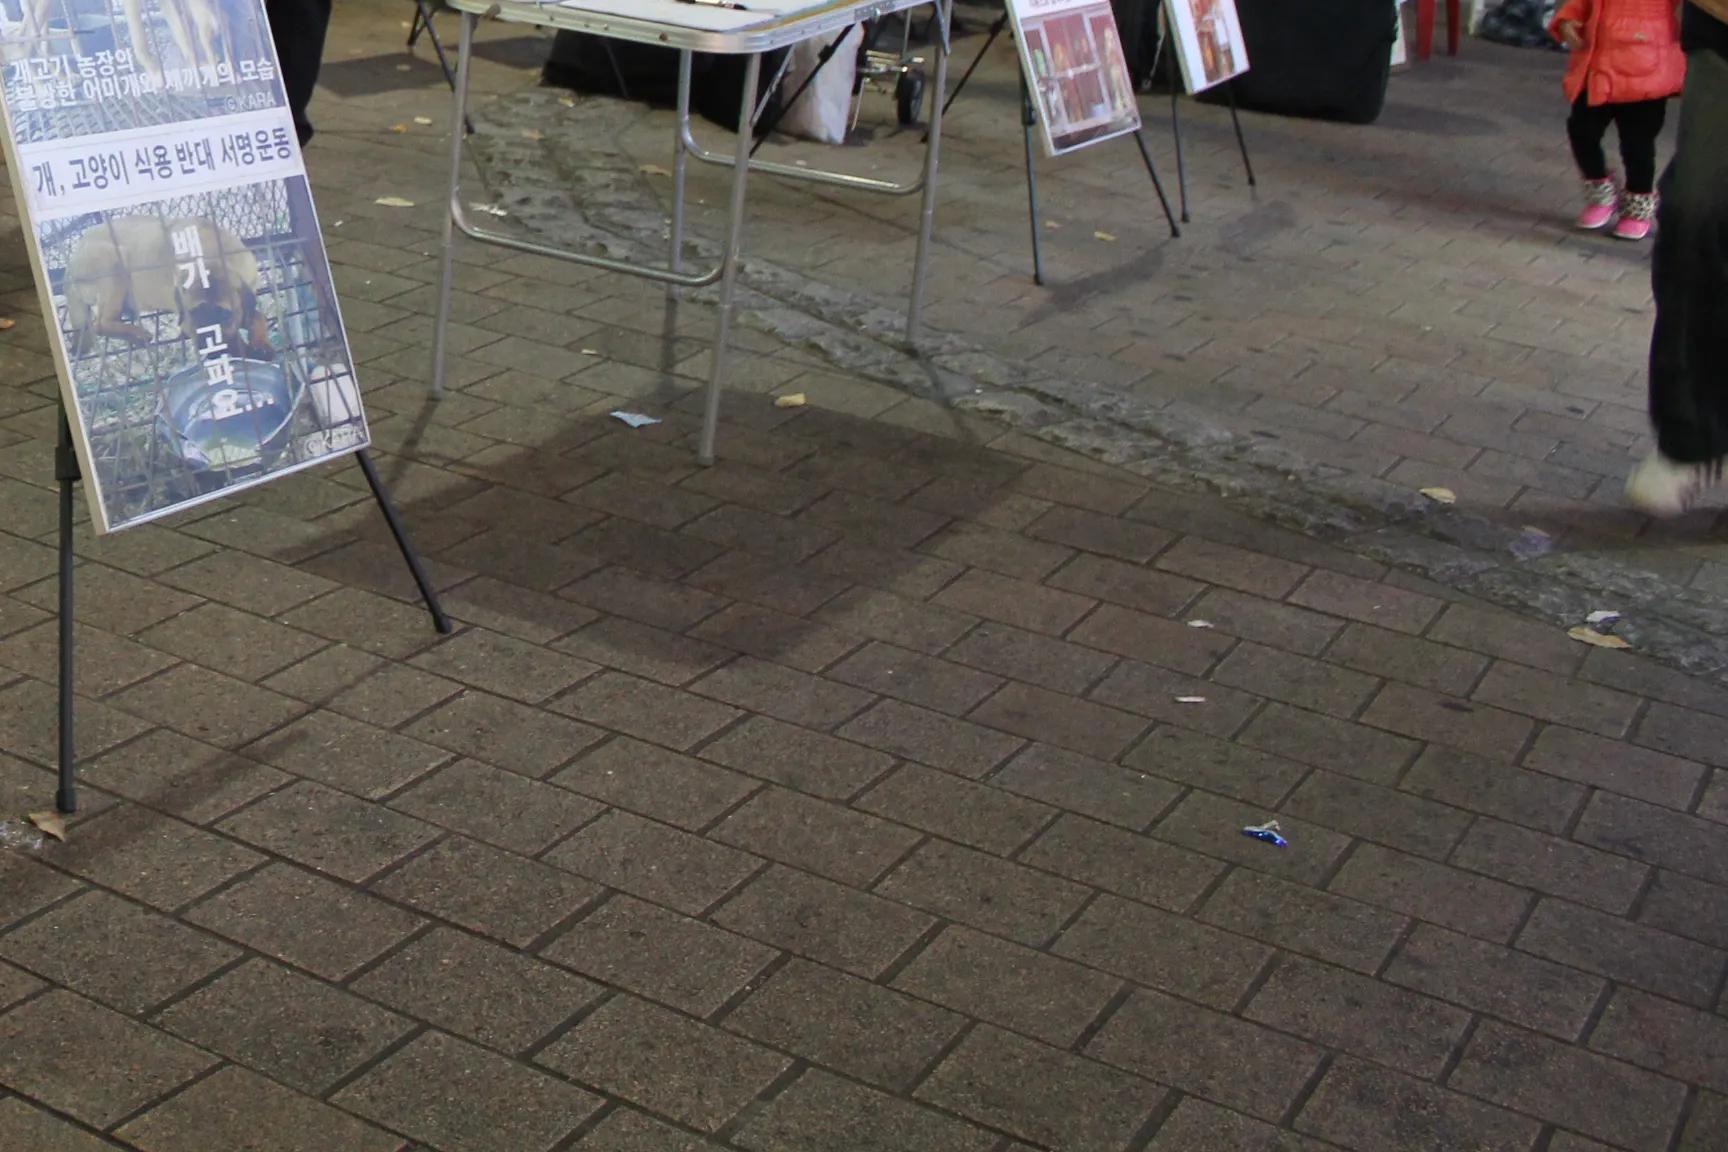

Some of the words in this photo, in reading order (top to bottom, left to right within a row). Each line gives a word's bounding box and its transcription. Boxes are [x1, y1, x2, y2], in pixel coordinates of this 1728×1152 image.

[11, 55, 70, 84] 개고기
[76, 47, 135, 80] 농장의
[239, 56, 275, 84] 모습
[31, 160, 66, 198] 개,
[68, 149, 131, 191] 고양이
[134, 144, 174, 181] 식용
[174, 137, 216, 175] 반대
[220, 126, 293, 168] 서명운동
[171, 224, 210, 290] 배가
